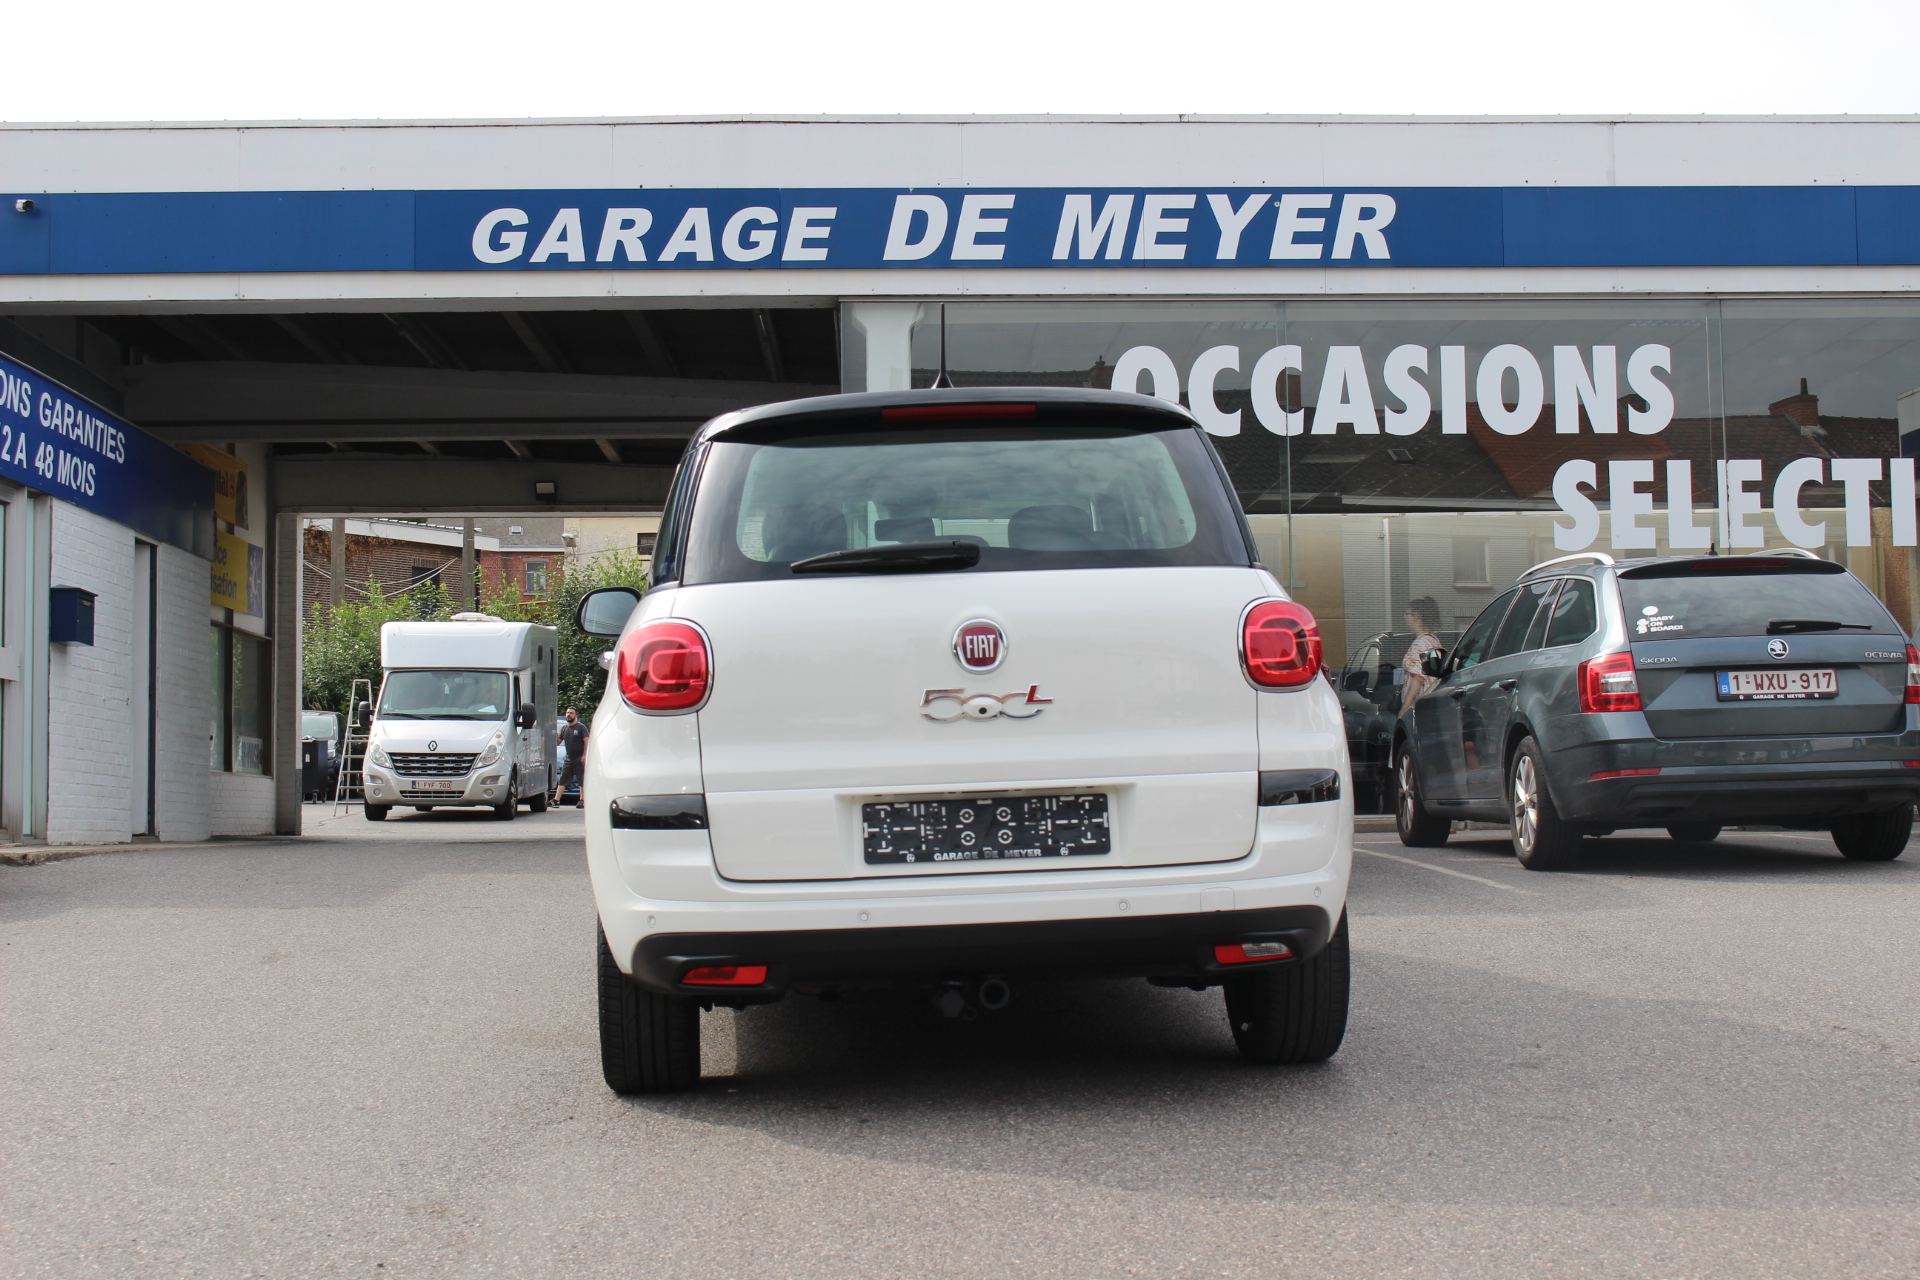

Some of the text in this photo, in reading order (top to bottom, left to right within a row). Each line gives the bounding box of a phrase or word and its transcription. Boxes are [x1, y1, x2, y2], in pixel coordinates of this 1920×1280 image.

[471, 193, 1398, 264] GARAGE DE MEYER
[1111, 343, 1675, 437] OCCASIONS
[39, 391, 126, 465] GARANTIES
[14, 432, 28, 469] A
[35, 441, 54, 480] 48
[57, 449, 97, 497] MOIS
[1551, 456, 1918, 551] SELECTI
[965, 634, 996, 659] FIAT
[1864, 651, 1903, 659] OCTAVIA
[1732, 672, 1833, 691] 1-WXU-917
[933, 848, 1042, 861] GARAGE DE MEYER
